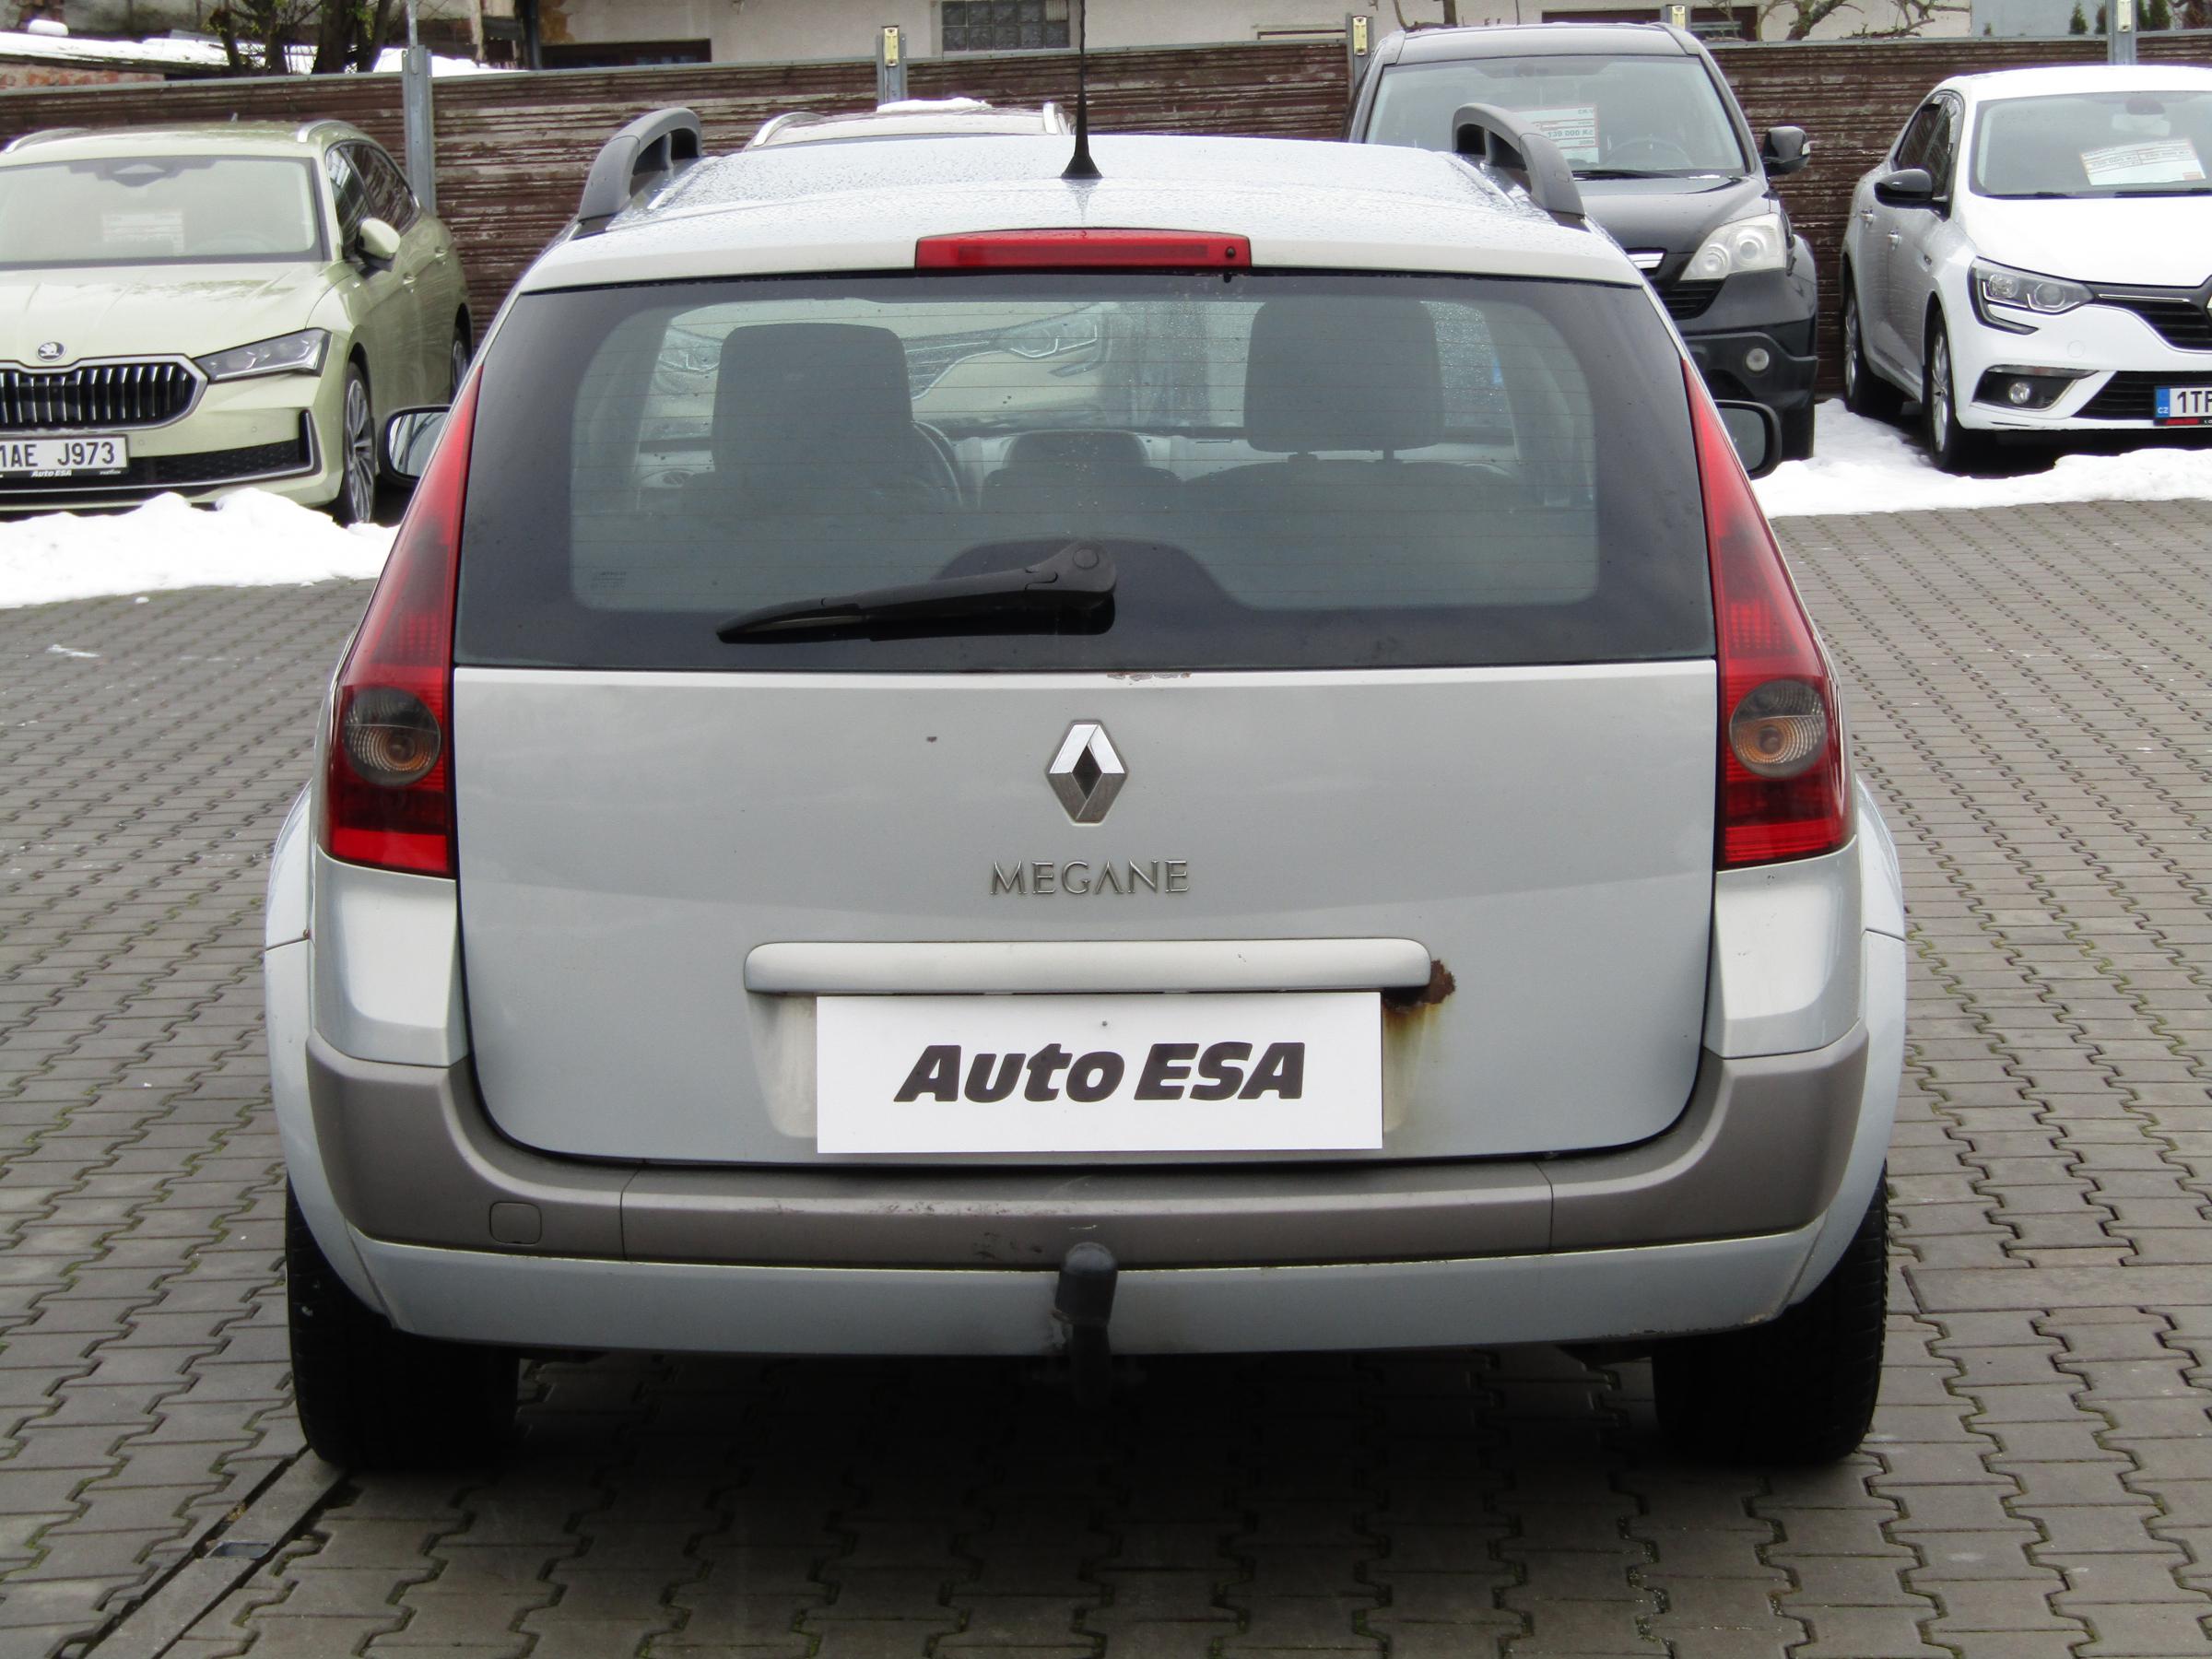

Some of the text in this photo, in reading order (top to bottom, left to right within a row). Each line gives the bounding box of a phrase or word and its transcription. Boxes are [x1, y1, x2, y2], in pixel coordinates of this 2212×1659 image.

[57, 441, 115, 465] J973
[54, 468, 72, 477] ESA
[990, 858, 1189, 895] MEGANE
[893, 1041, 1305, 1103] Auto ESA
